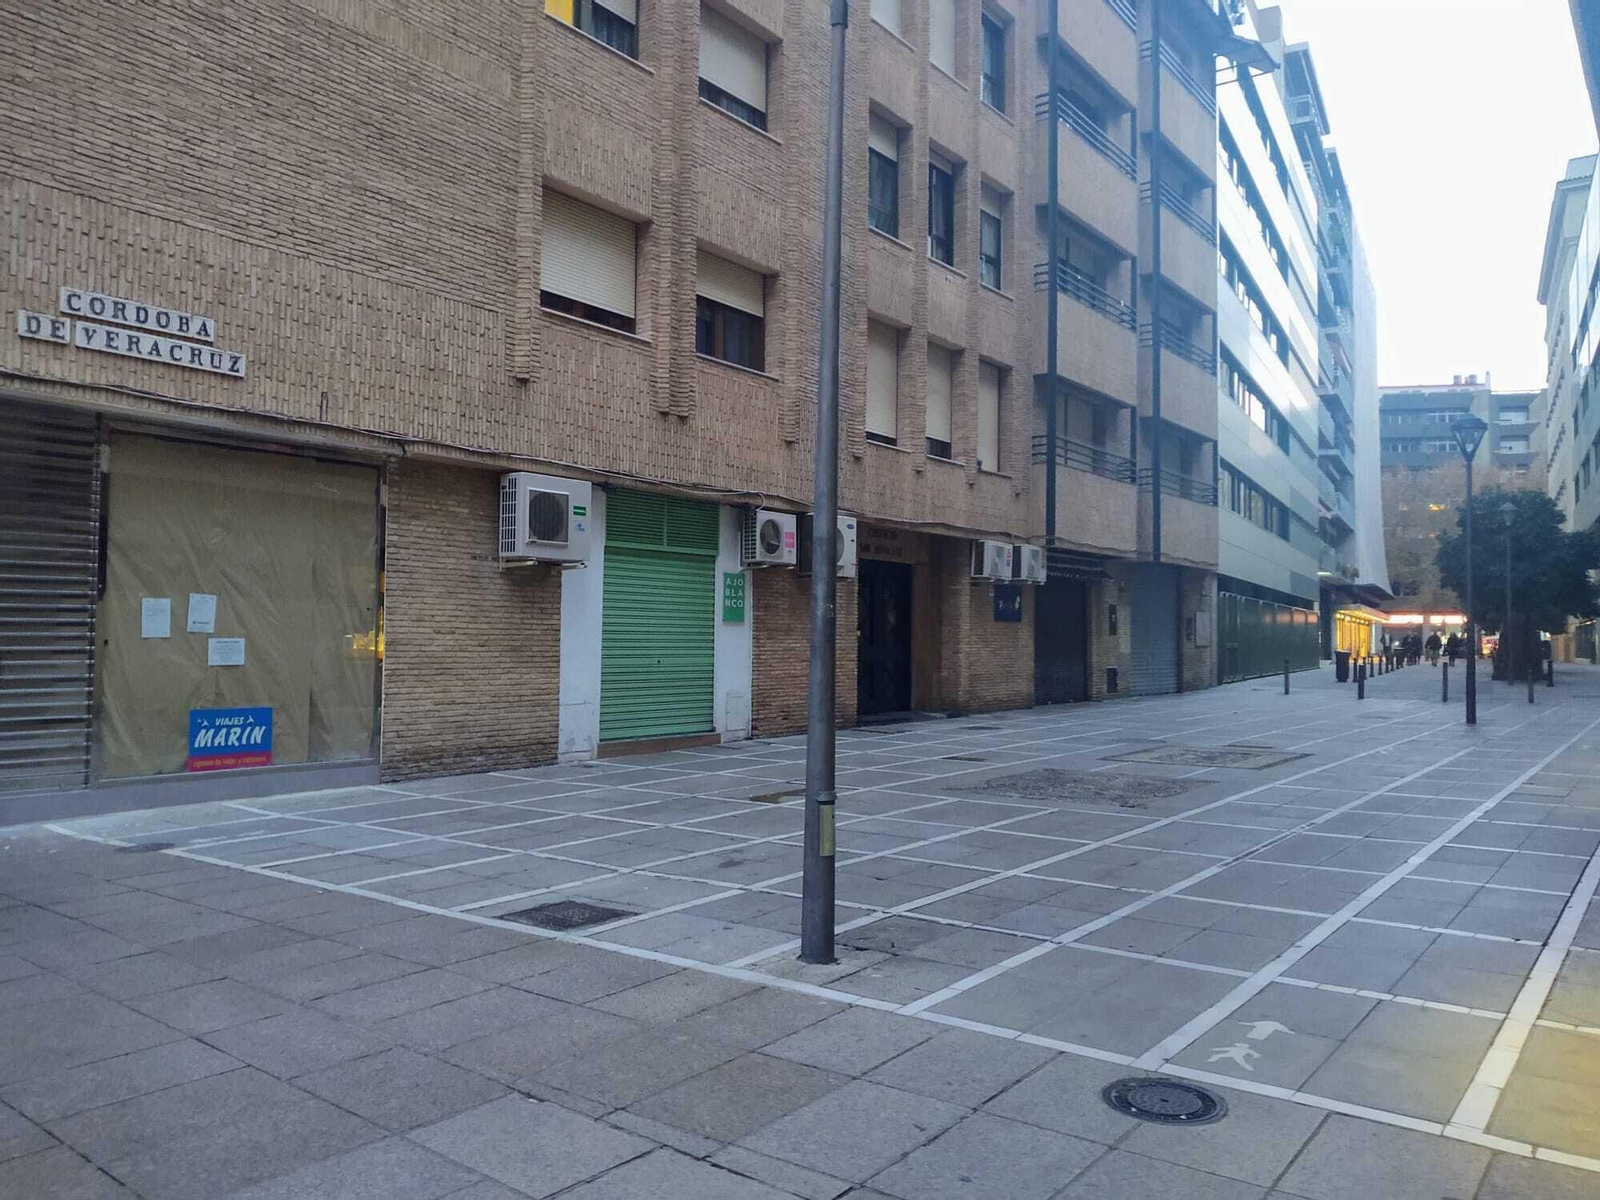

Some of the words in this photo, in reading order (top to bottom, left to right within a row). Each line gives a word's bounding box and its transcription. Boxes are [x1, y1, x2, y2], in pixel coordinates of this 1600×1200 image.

[66, 293, 212, 338] CORDOBA
[25, 315, 66, 340] DE
[82, 327, 242, 373] VERACRUZ
[725, 577, 744, 587] AJO
[725, 588, 744, 597] BLA
[724, 599, 744, 608] NCO
[215, 716, 245, 726] VIAJES
[194, 726, 266, 748] MARIN
